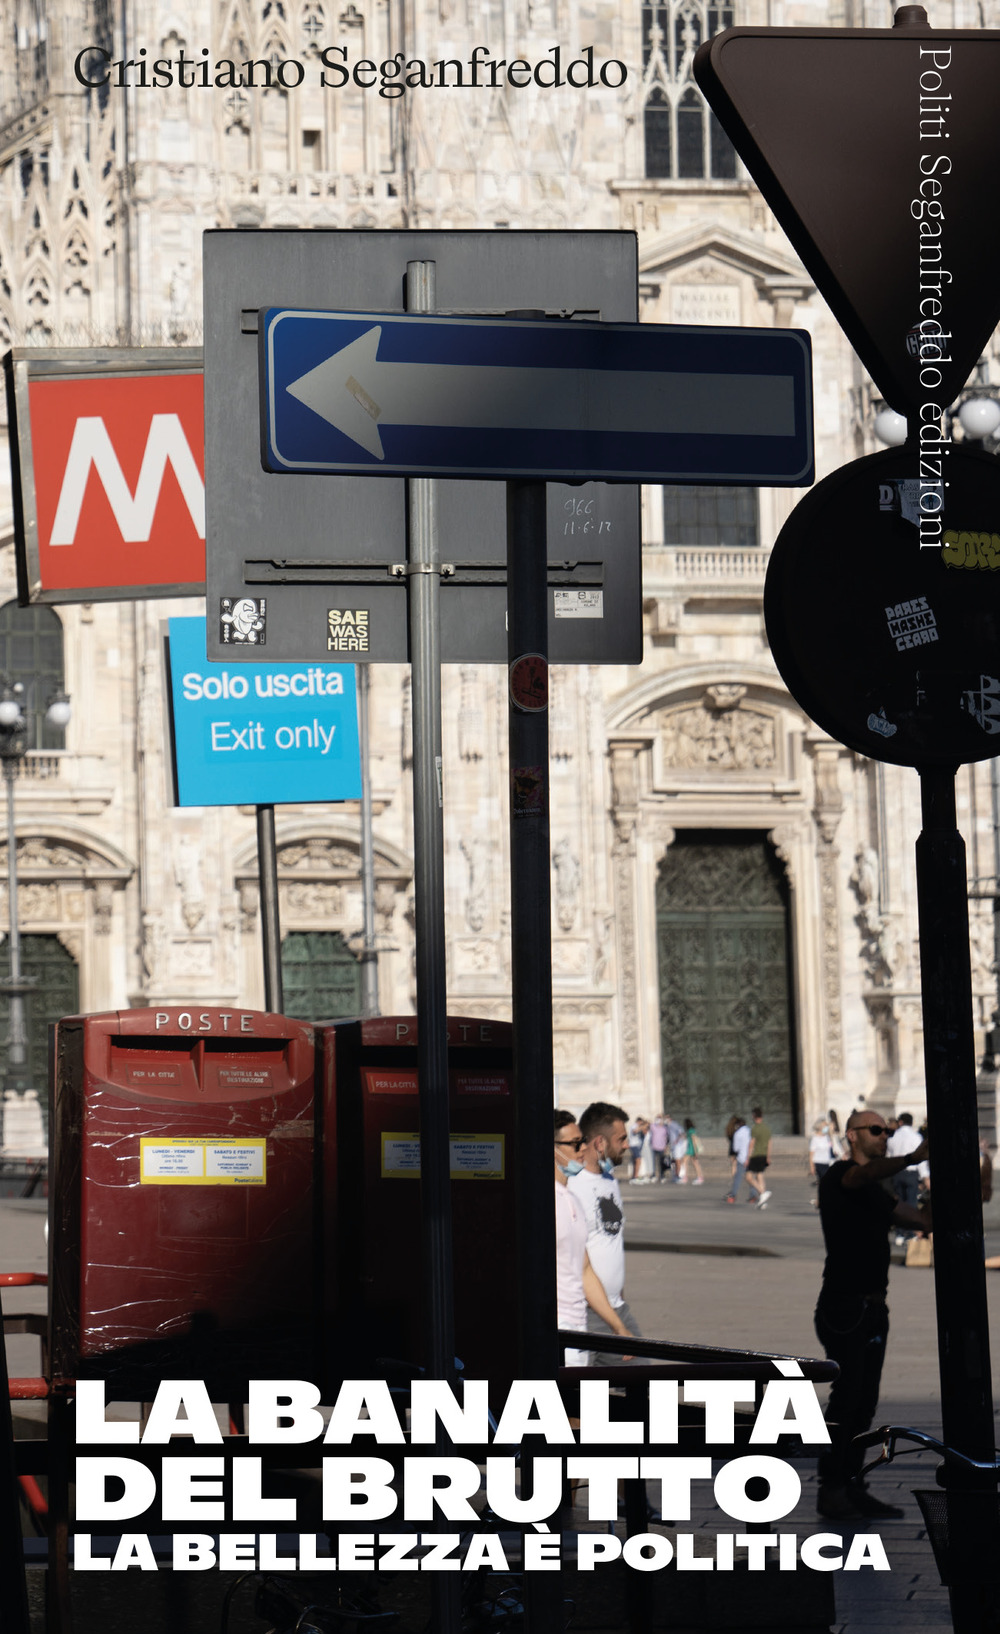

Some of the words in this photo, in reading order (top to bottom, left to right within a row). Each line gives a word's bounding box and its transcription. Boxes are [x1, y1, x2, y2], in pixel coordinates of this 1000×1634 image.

[49, 413, 205, 546] M
[328, 609, 368, 625] SAE
[329, 625, 368, 638] WAS
[328, 637, 369, 651] HERE
[182, 671, 249, 700] Solo
[255, 667, 344, 698] uscita
[211, 721, 265, 751] Exit
[275, 718, 336, 755] only
[155, 1012, 254, 1032] POSTE
[396, 1023, 493, 1042] PTE
[376, 1080, 389, 1088] PER
